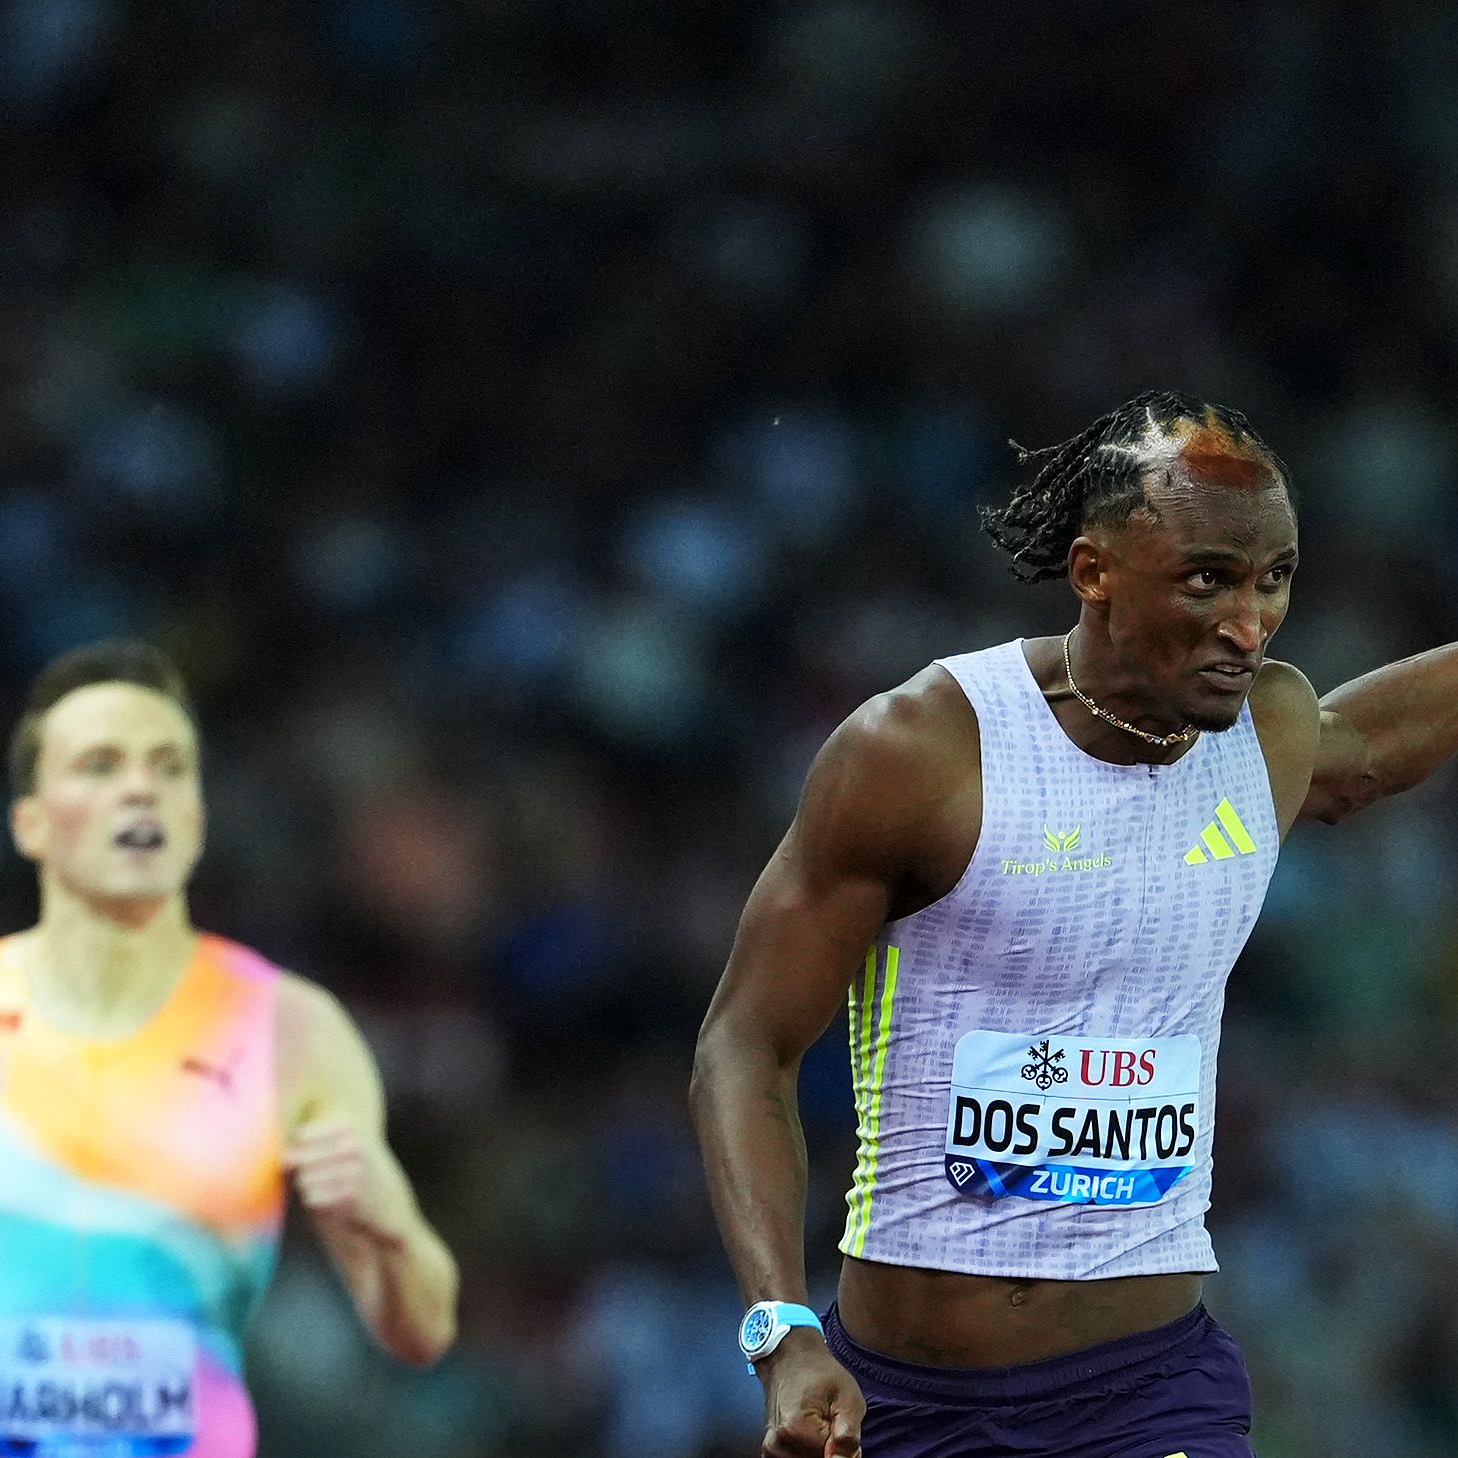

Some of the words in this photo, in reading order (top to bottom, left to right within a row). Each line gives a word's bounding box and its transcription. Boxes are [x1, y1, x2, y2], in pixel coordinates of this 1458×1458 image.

[1001, 858, 1058, 877] Tirop's
[1061, 853, 1112, 872] Angels
[1079, 1049, 1157, 1087] UBS
[952, 1095, 1041, 1155] DOS
[1047, 1103, 1195, 1161] SANTOS
[1029, 1170, 1135, 1200] ZURICH
